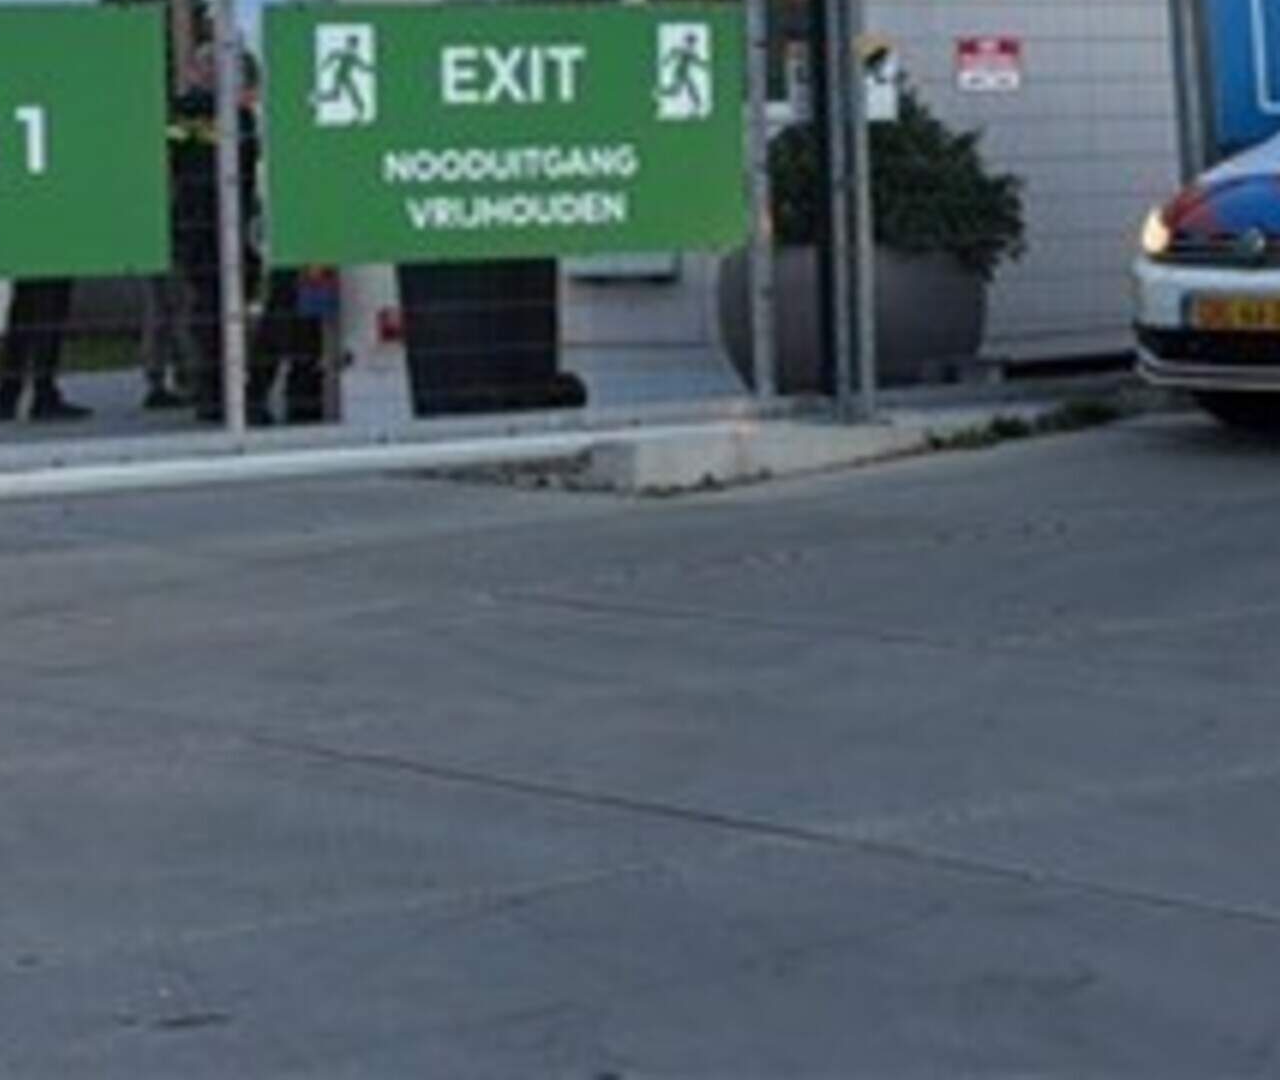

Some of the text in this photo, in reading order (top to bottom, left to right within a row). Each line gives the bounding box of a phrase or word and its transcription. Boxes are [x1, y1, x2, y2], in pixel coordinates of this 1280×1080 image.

[440, 45, 586, 104] EXIT
[15, 106, 47, 174] 1
[383, 143, 639, 182] NOODUITGANG
[405, 190, 626, 230] VRIJHOUDEN
